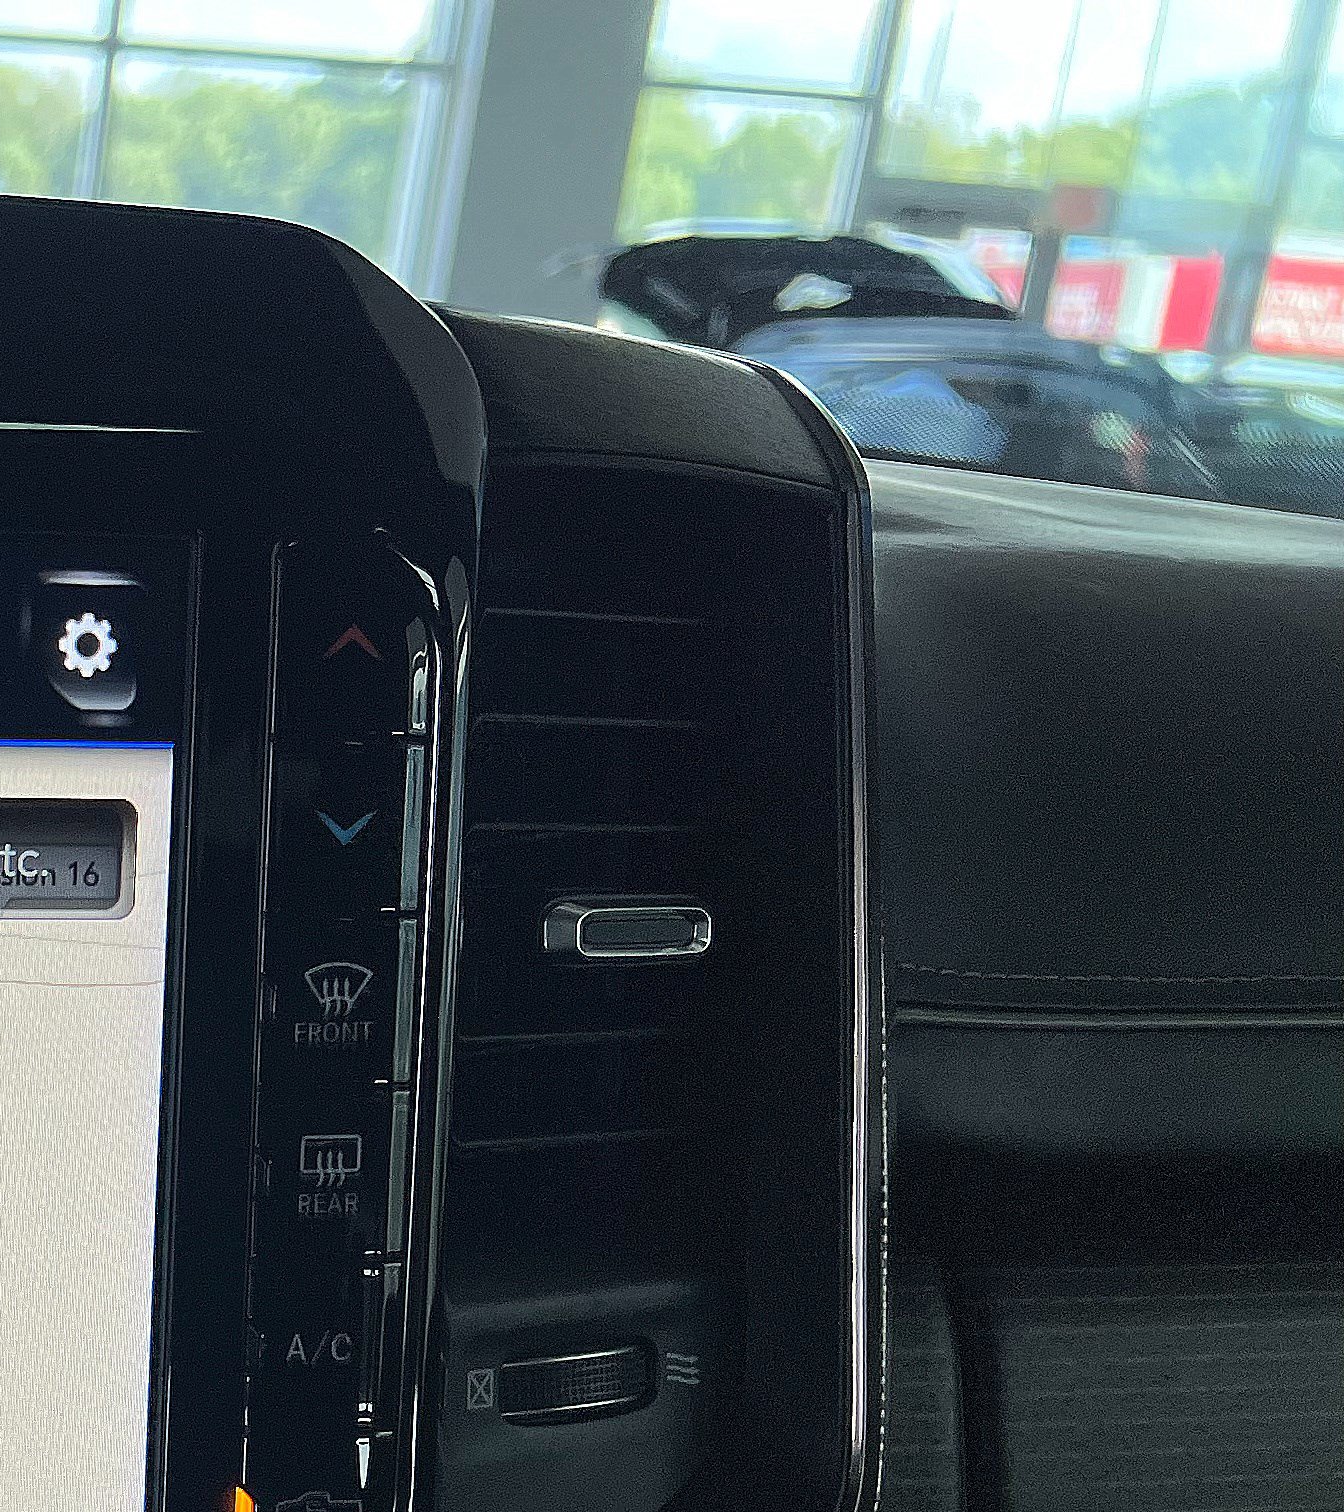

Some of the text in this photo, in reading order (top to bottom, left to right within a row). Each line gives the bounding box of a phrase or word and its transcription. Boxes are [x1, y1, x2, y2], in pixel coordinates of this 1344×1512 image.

[68, 862, 101, 887] 16
[294, 1020, 374, 1044] FRONT
[298, 1193, 359, 1215] REAR
[285, 1331, 353, 1363] A/C
